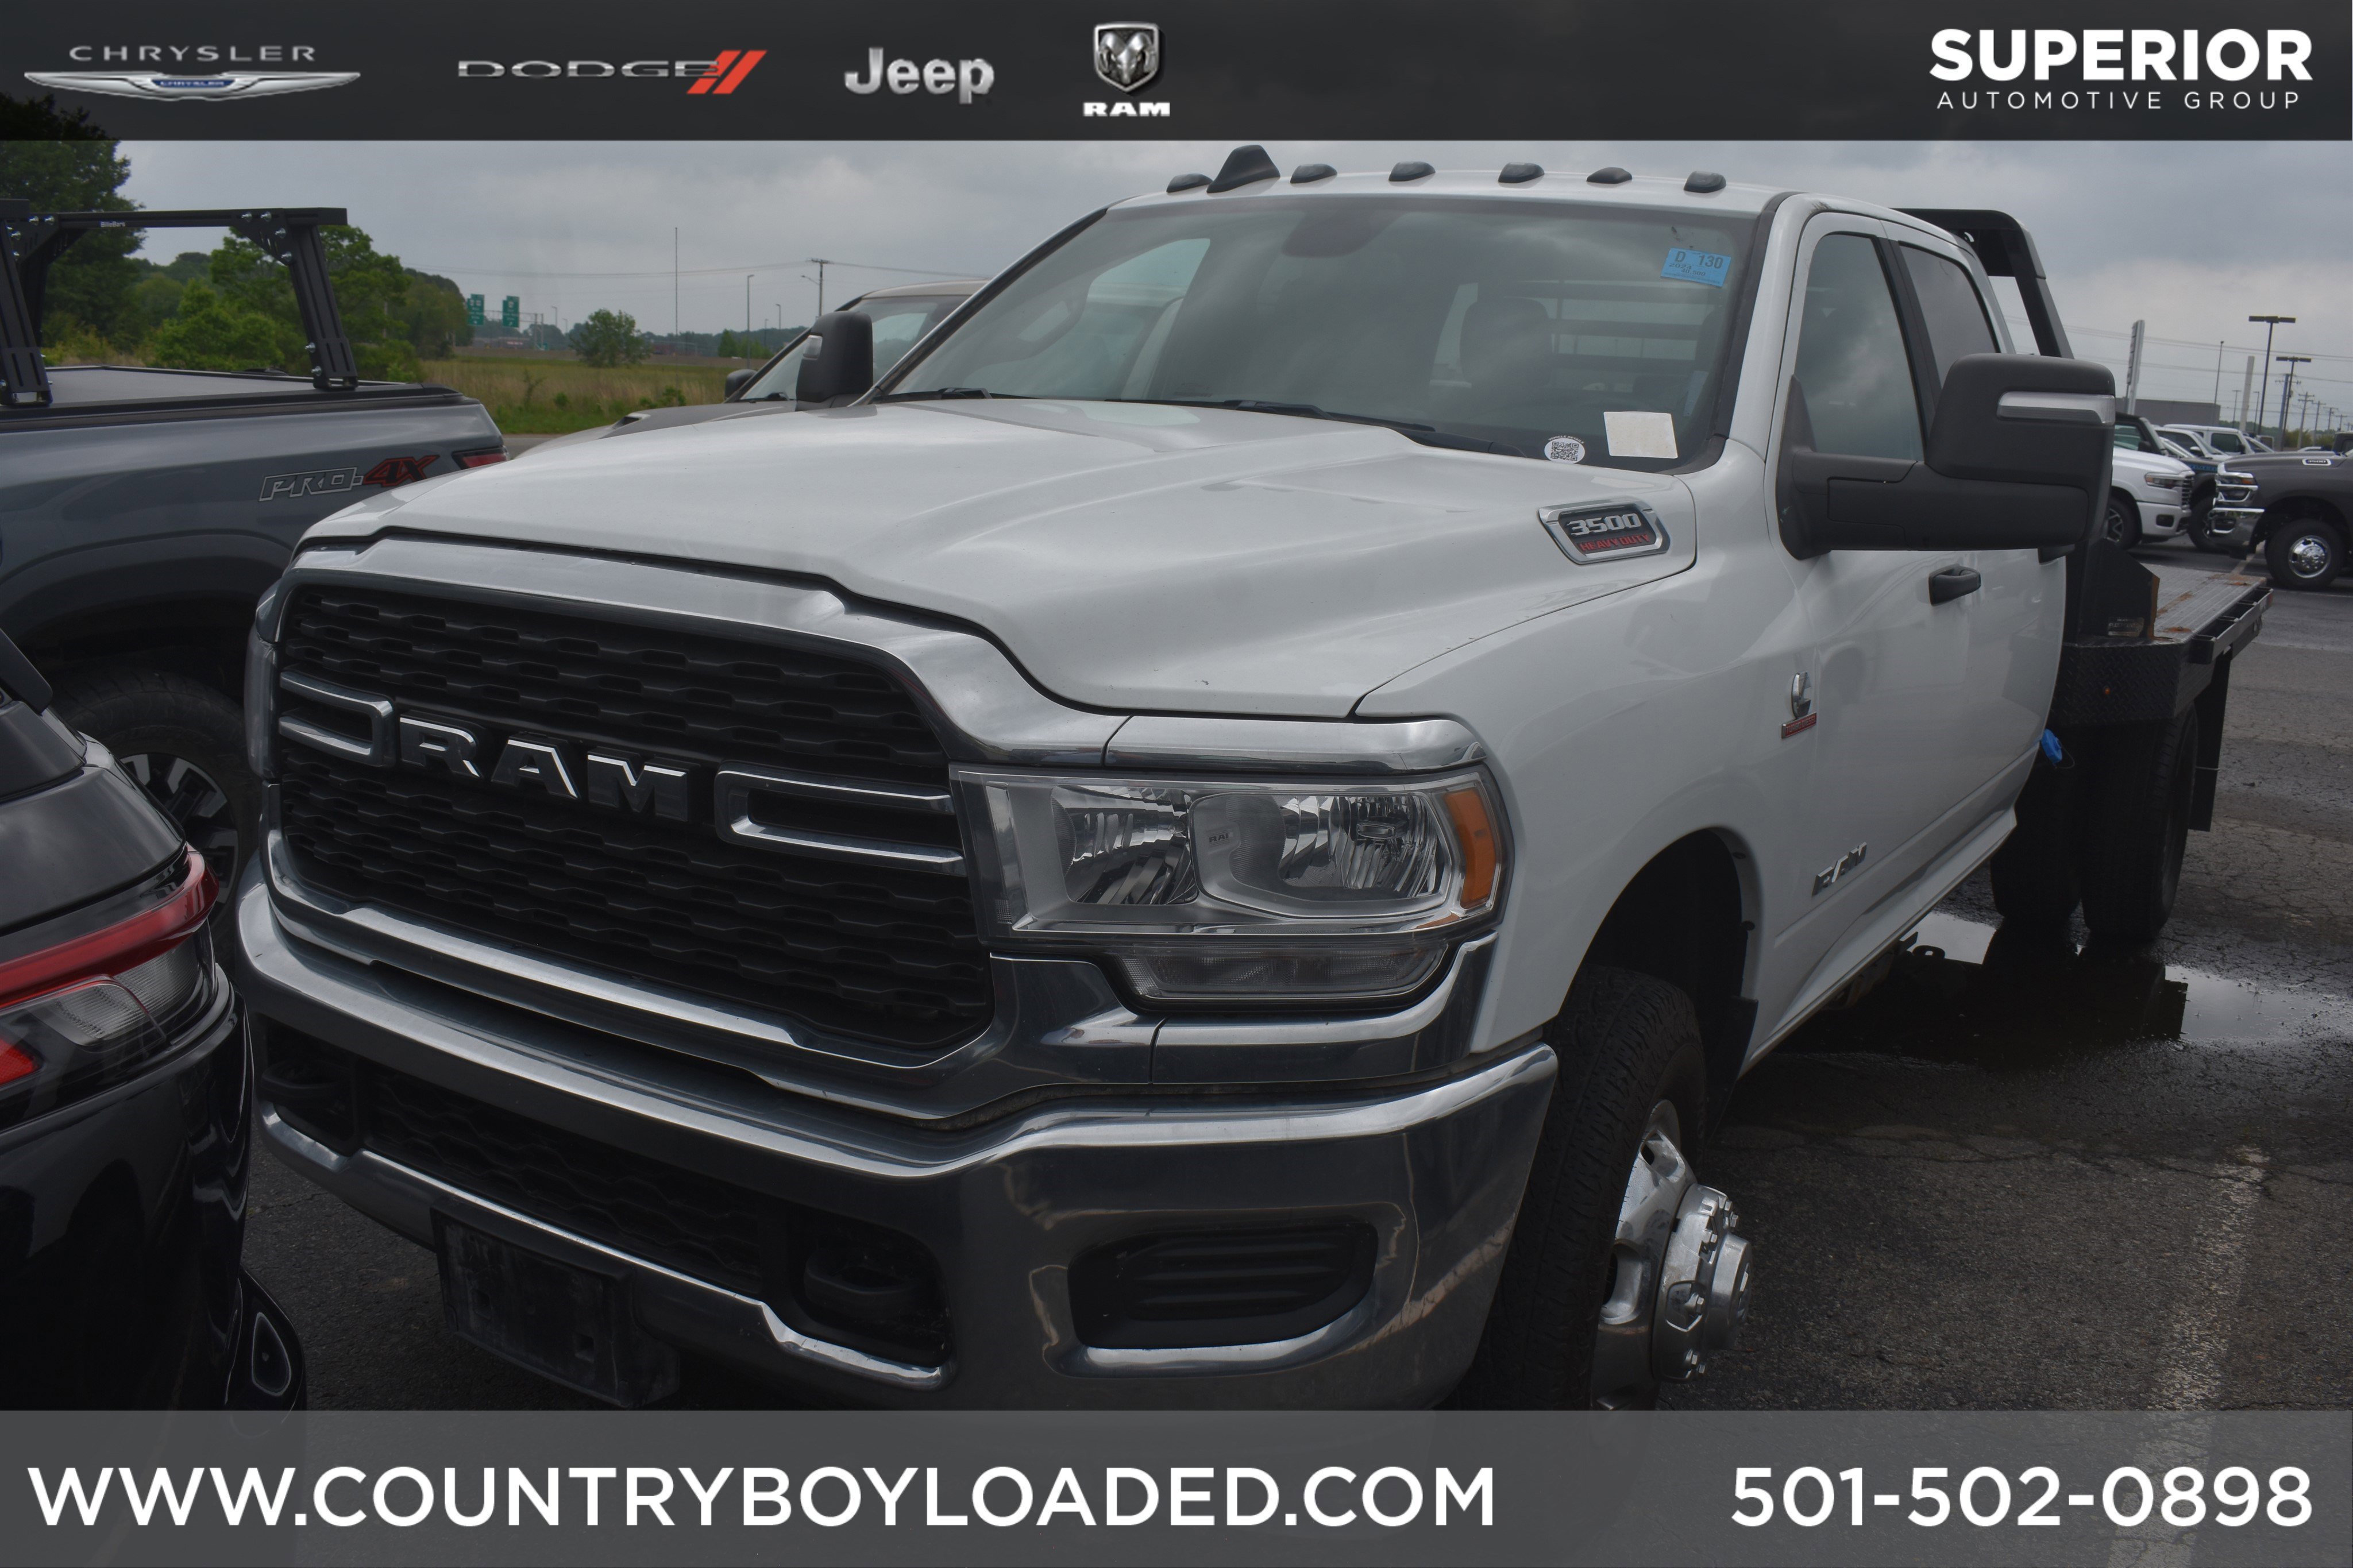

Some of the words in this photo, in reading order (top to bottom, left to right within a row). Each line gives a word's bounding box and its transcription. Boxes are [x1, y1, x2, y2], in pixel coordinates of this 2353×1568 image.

[1675, 251, 1686, 262] D
[1699, 254, 1724, 269] 130
[258, 454, 441, 502] PRO-4X
[1568, 513, 1642, 536] 3500
[1580, 539, 1618, 551] HEAVY
[1621, 534, 1651, 545] DUTY
[400, 712, 693, 821] RAM
